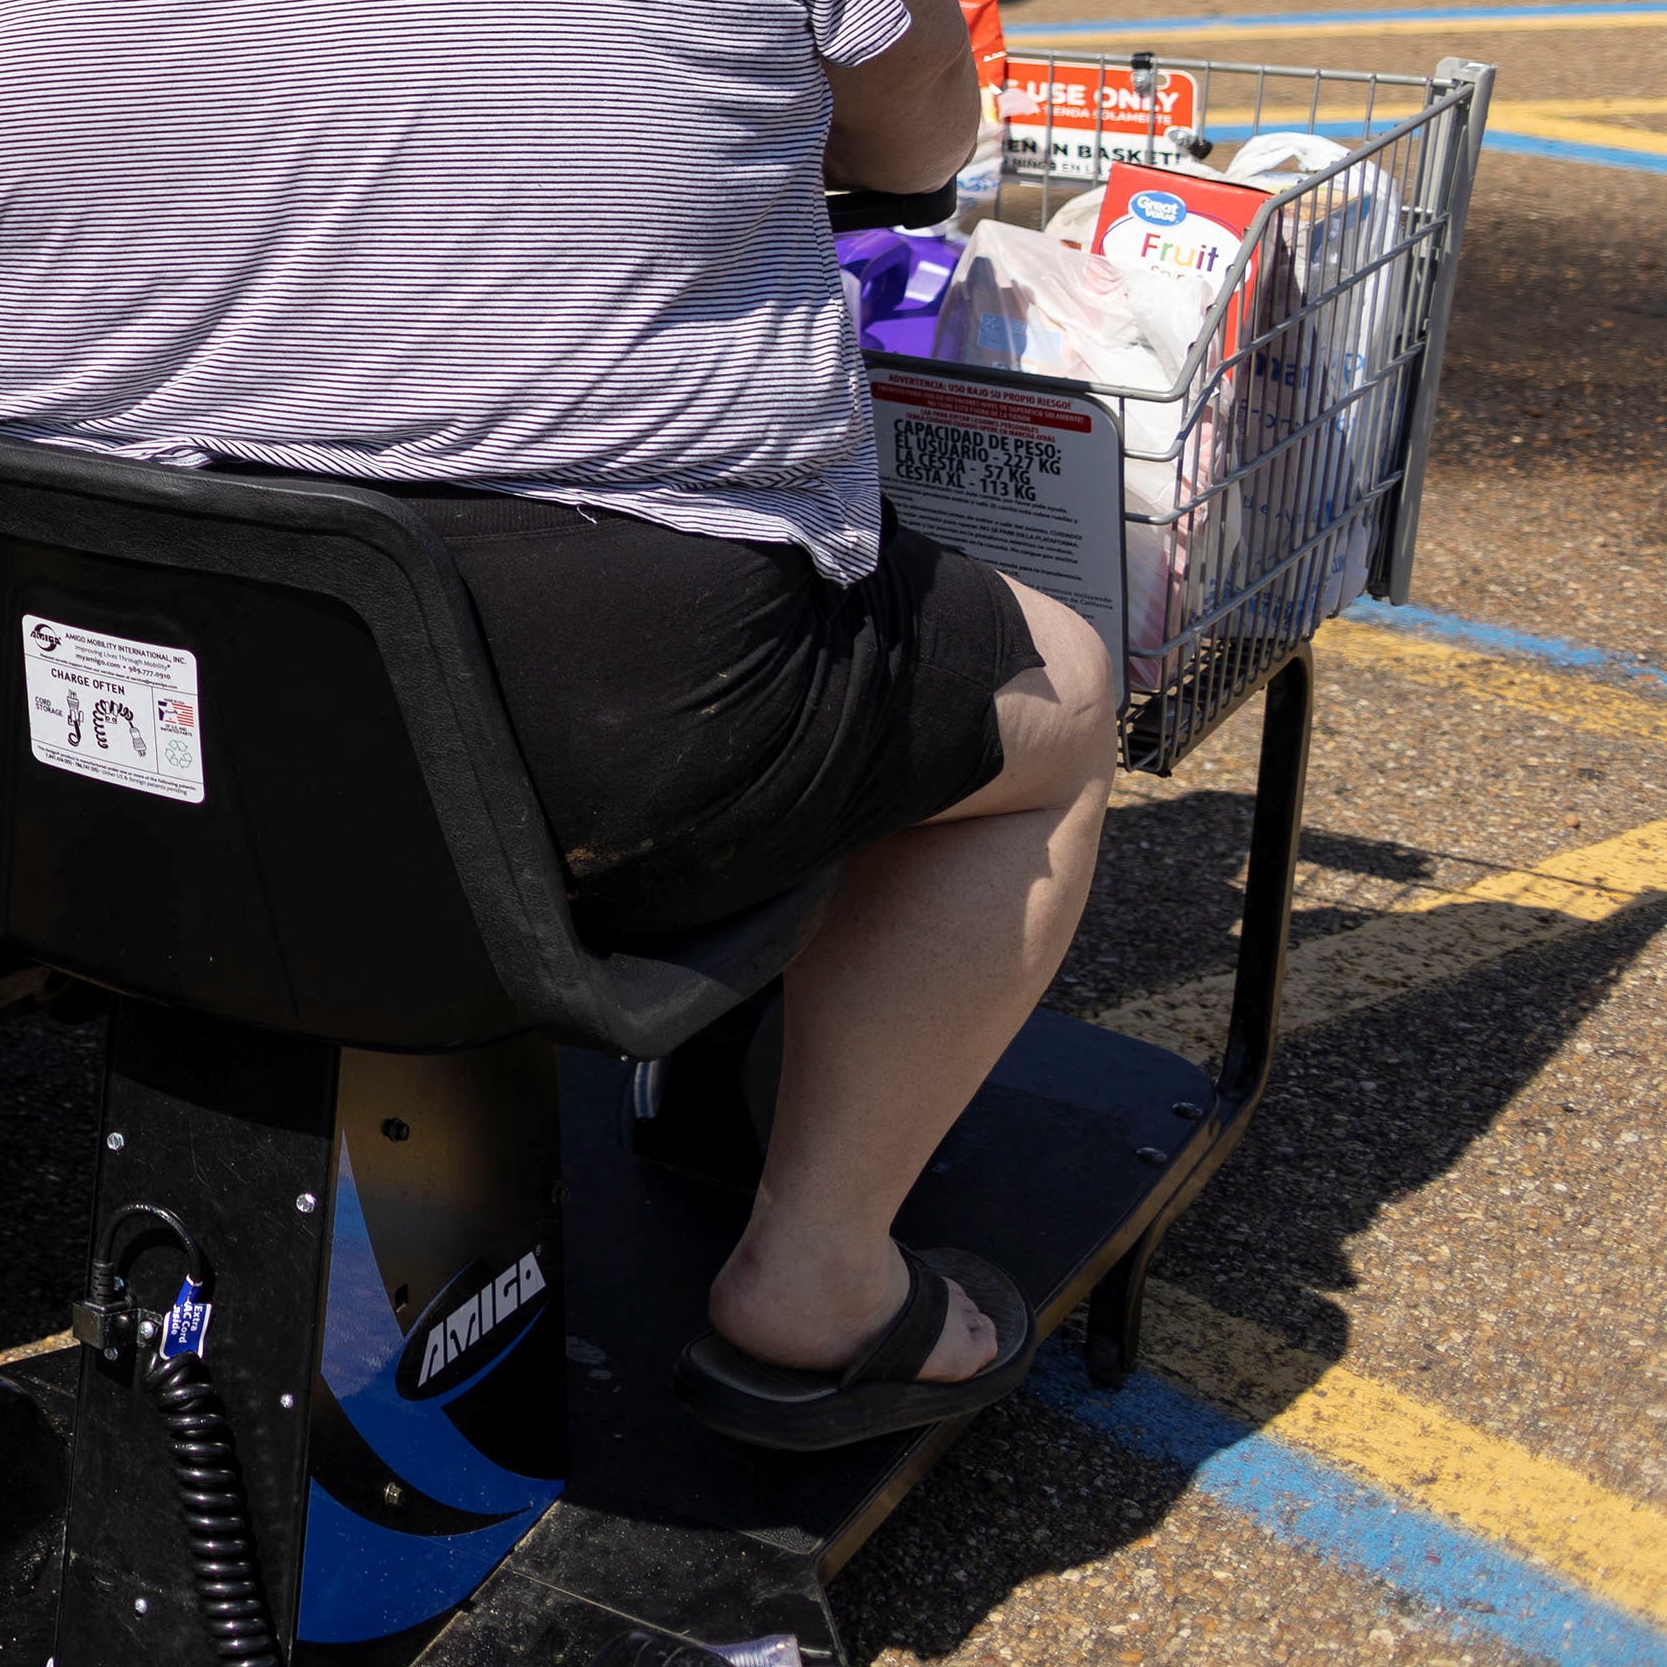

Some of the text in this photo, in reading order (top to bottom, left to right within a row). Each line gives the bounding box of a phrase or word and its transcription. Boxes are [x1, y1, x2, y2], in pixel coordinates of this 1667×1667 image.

[1027, 81, 1086, 107] USE
[1137, 195, 1178, 216] Great
[1145, 209, 1176, 223] Value
[1141, 232, 1219, 272] Fruit
[967, 385, 988, 397] BAJO
[990, 389, 1001, 399] SU
[1003, 391, 1035, 405] PROPIO
[894, 419, 1062, 461] CAPACIDAD DE PESO:
[894, 435, 912, 450] EL
[917, 438, 988, 464] USUARIO
[1004, 453, 1034, 470] 227
[1039, 457, 1061, 476] KG
[895, 448, 913, 465] LA
[919, 452, 966, 474] CESTA
[984, 464, 1004, 480] 57
[1009, 468, 1031, 486] KG
[895, 463, 941, 485] CESTA
[946, 472, 965, 489] XL
[981, 478, 1008, 498] 113
[1016, 484, 1036, 502] KG
[65, 632, 187, 665] AMIGO MOBILITY INTERNATIONAL, INC.
[75, 645, 102, 658] Improving
[104, 651, 118, 660] Lives
[119, 654, 142, 666] Through
[75, 653, 121, 670] myamigo.com
[51, 667, 125, 696] CHARGE OFTEN
[35, 696, 51, 710] CORD
[35, 704, 63, 718] STORAGE
[179, 1303, 193, 1343] AC Cord
[191, 1305, 203, 1331] Extra
[417, 1251, 546, 1388] AMIGO
